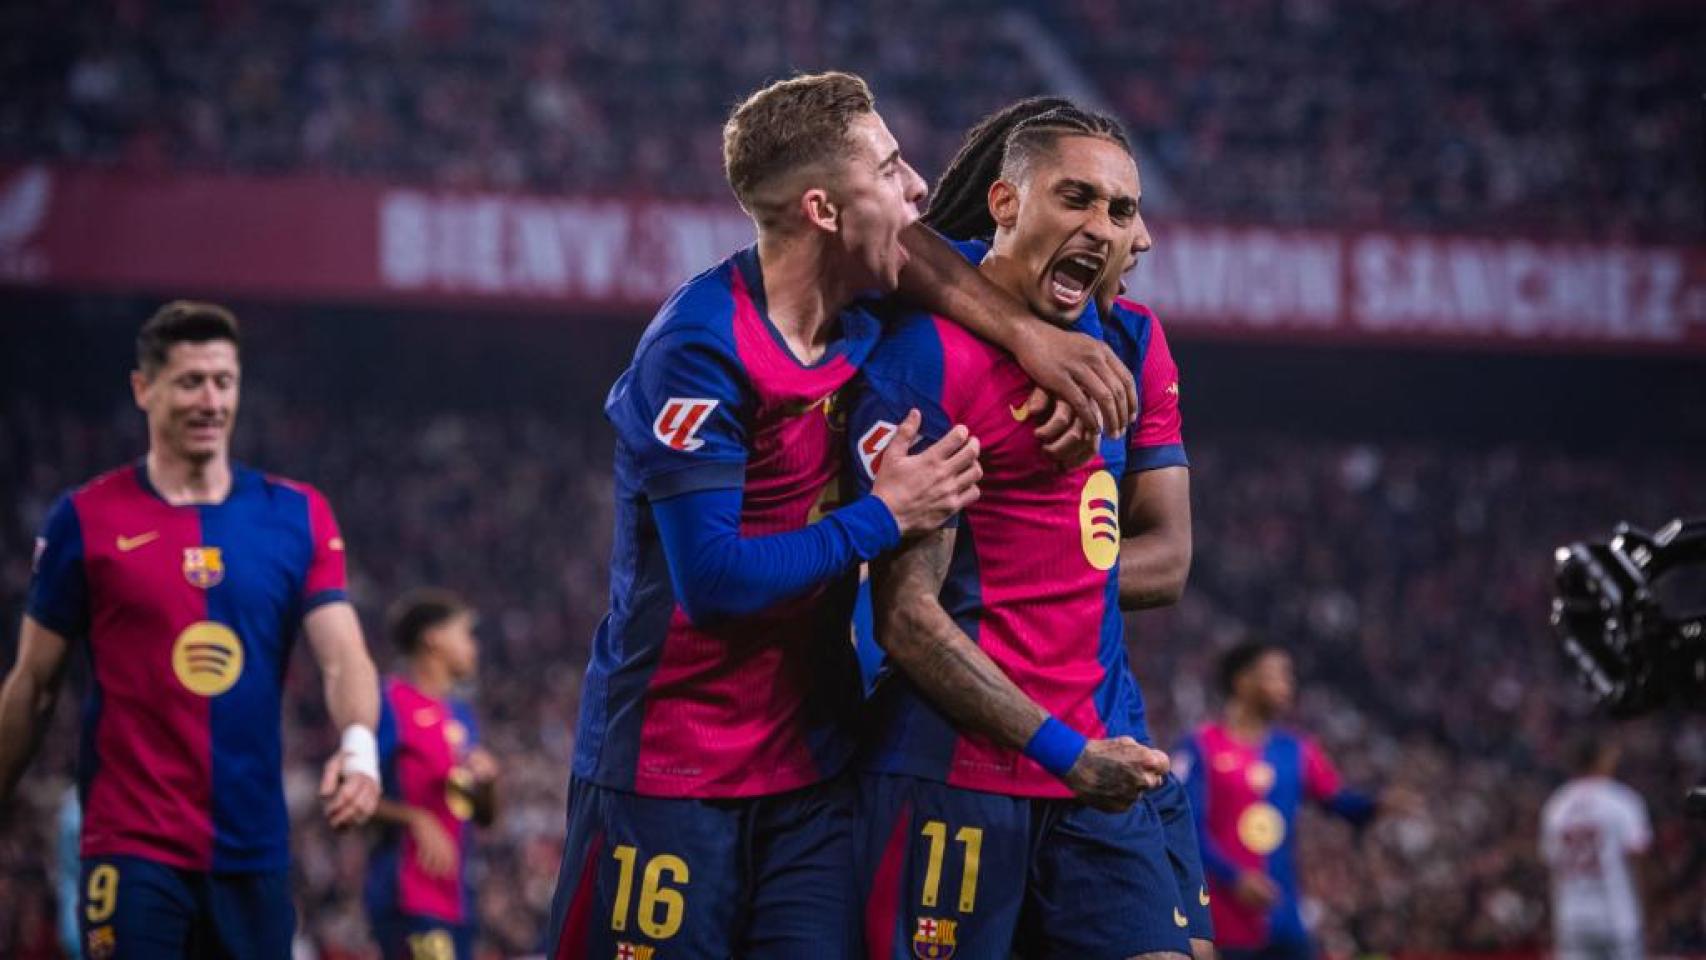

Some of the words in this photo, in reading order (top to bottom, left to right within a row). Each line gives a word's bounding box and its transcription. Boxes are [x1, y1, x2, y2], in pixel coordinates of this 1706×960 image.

[86, 864, 119, 922] 9
[611, 844, 690, 940] 16
[921, 819, 983, 913] 11
